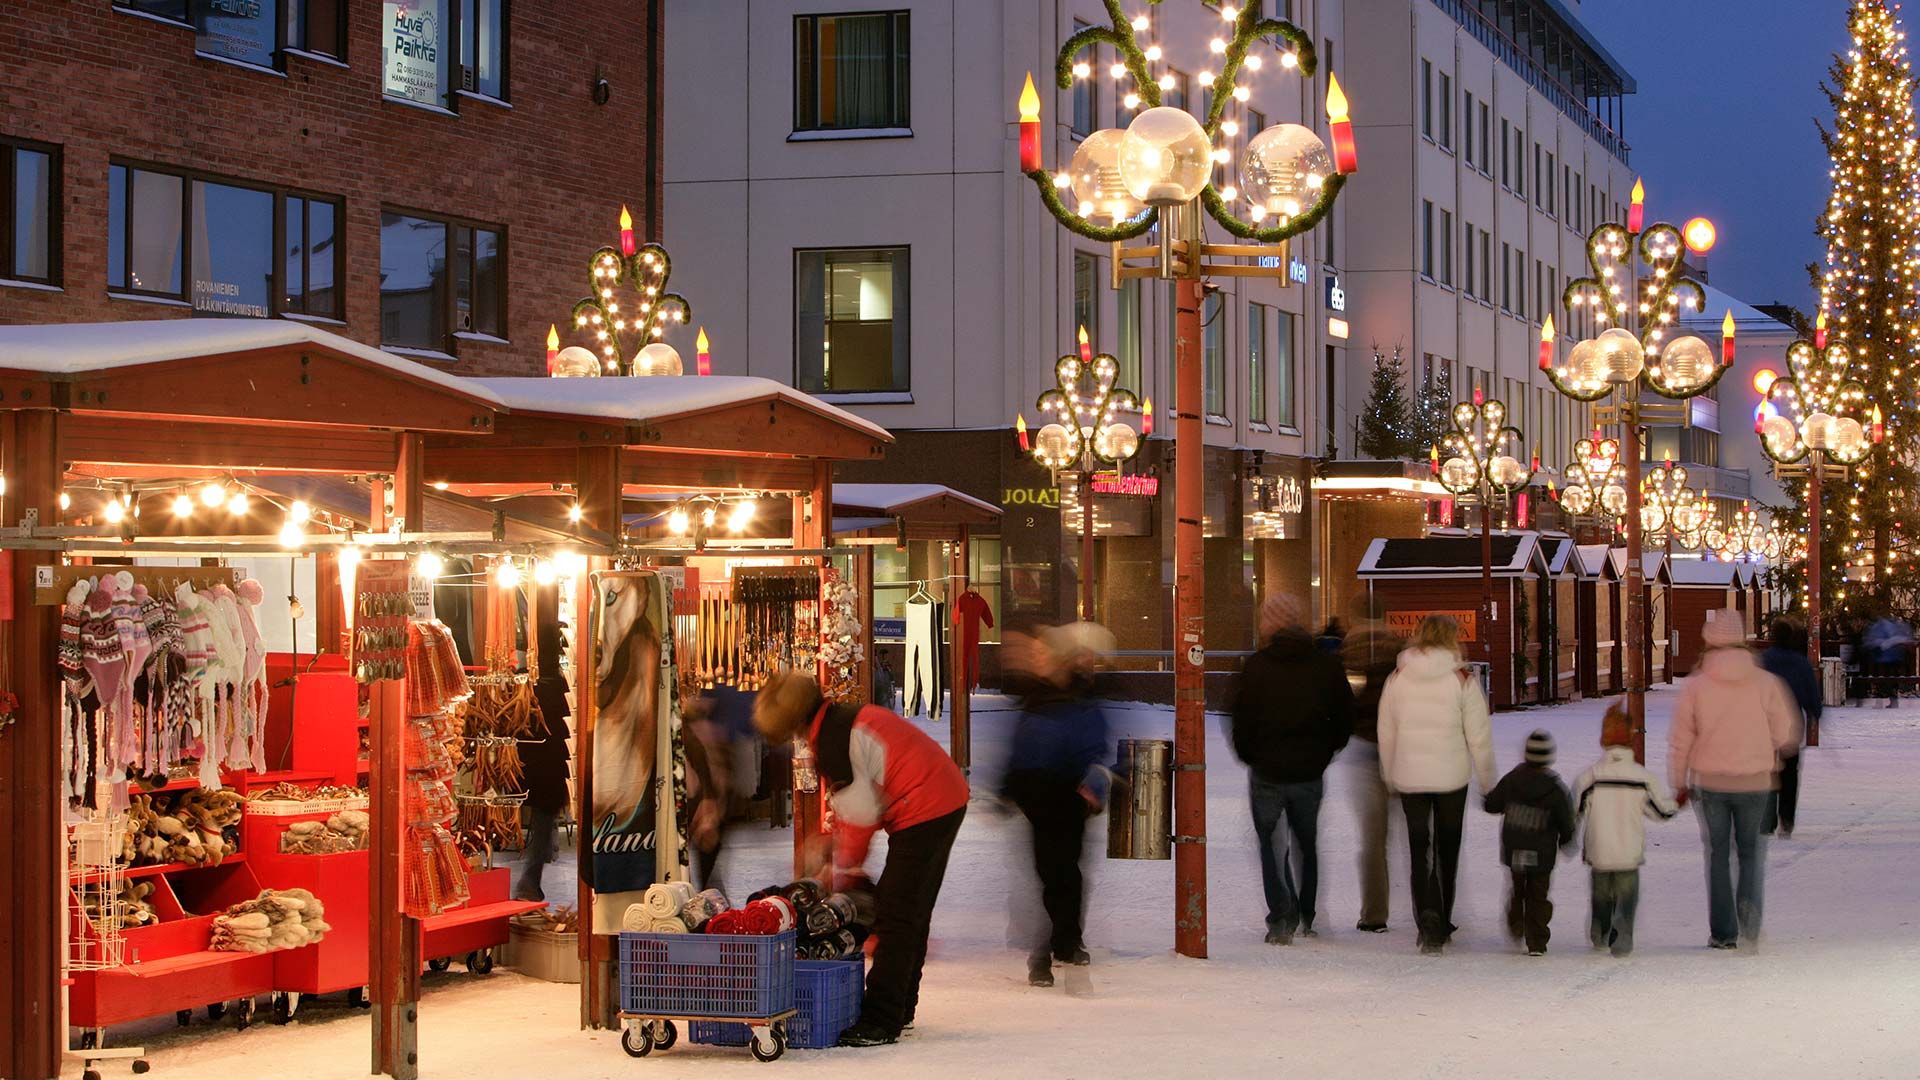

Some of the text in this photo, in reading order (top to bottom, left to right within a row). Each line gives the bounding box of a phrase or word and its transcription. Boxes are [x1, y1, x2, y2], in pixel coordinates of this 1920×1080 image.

[395, 12, 423, 33] Hyvä
[395, 35, 436, 63] Paikka
[404, 85, 426, 97] DENTIST
[196, 280, 239, 296] ROVANIEMEN
[196, 297, 268, 318] LÄÄKINTÄVOIMISTELU
[1026, 517, 1035, 528] 2
